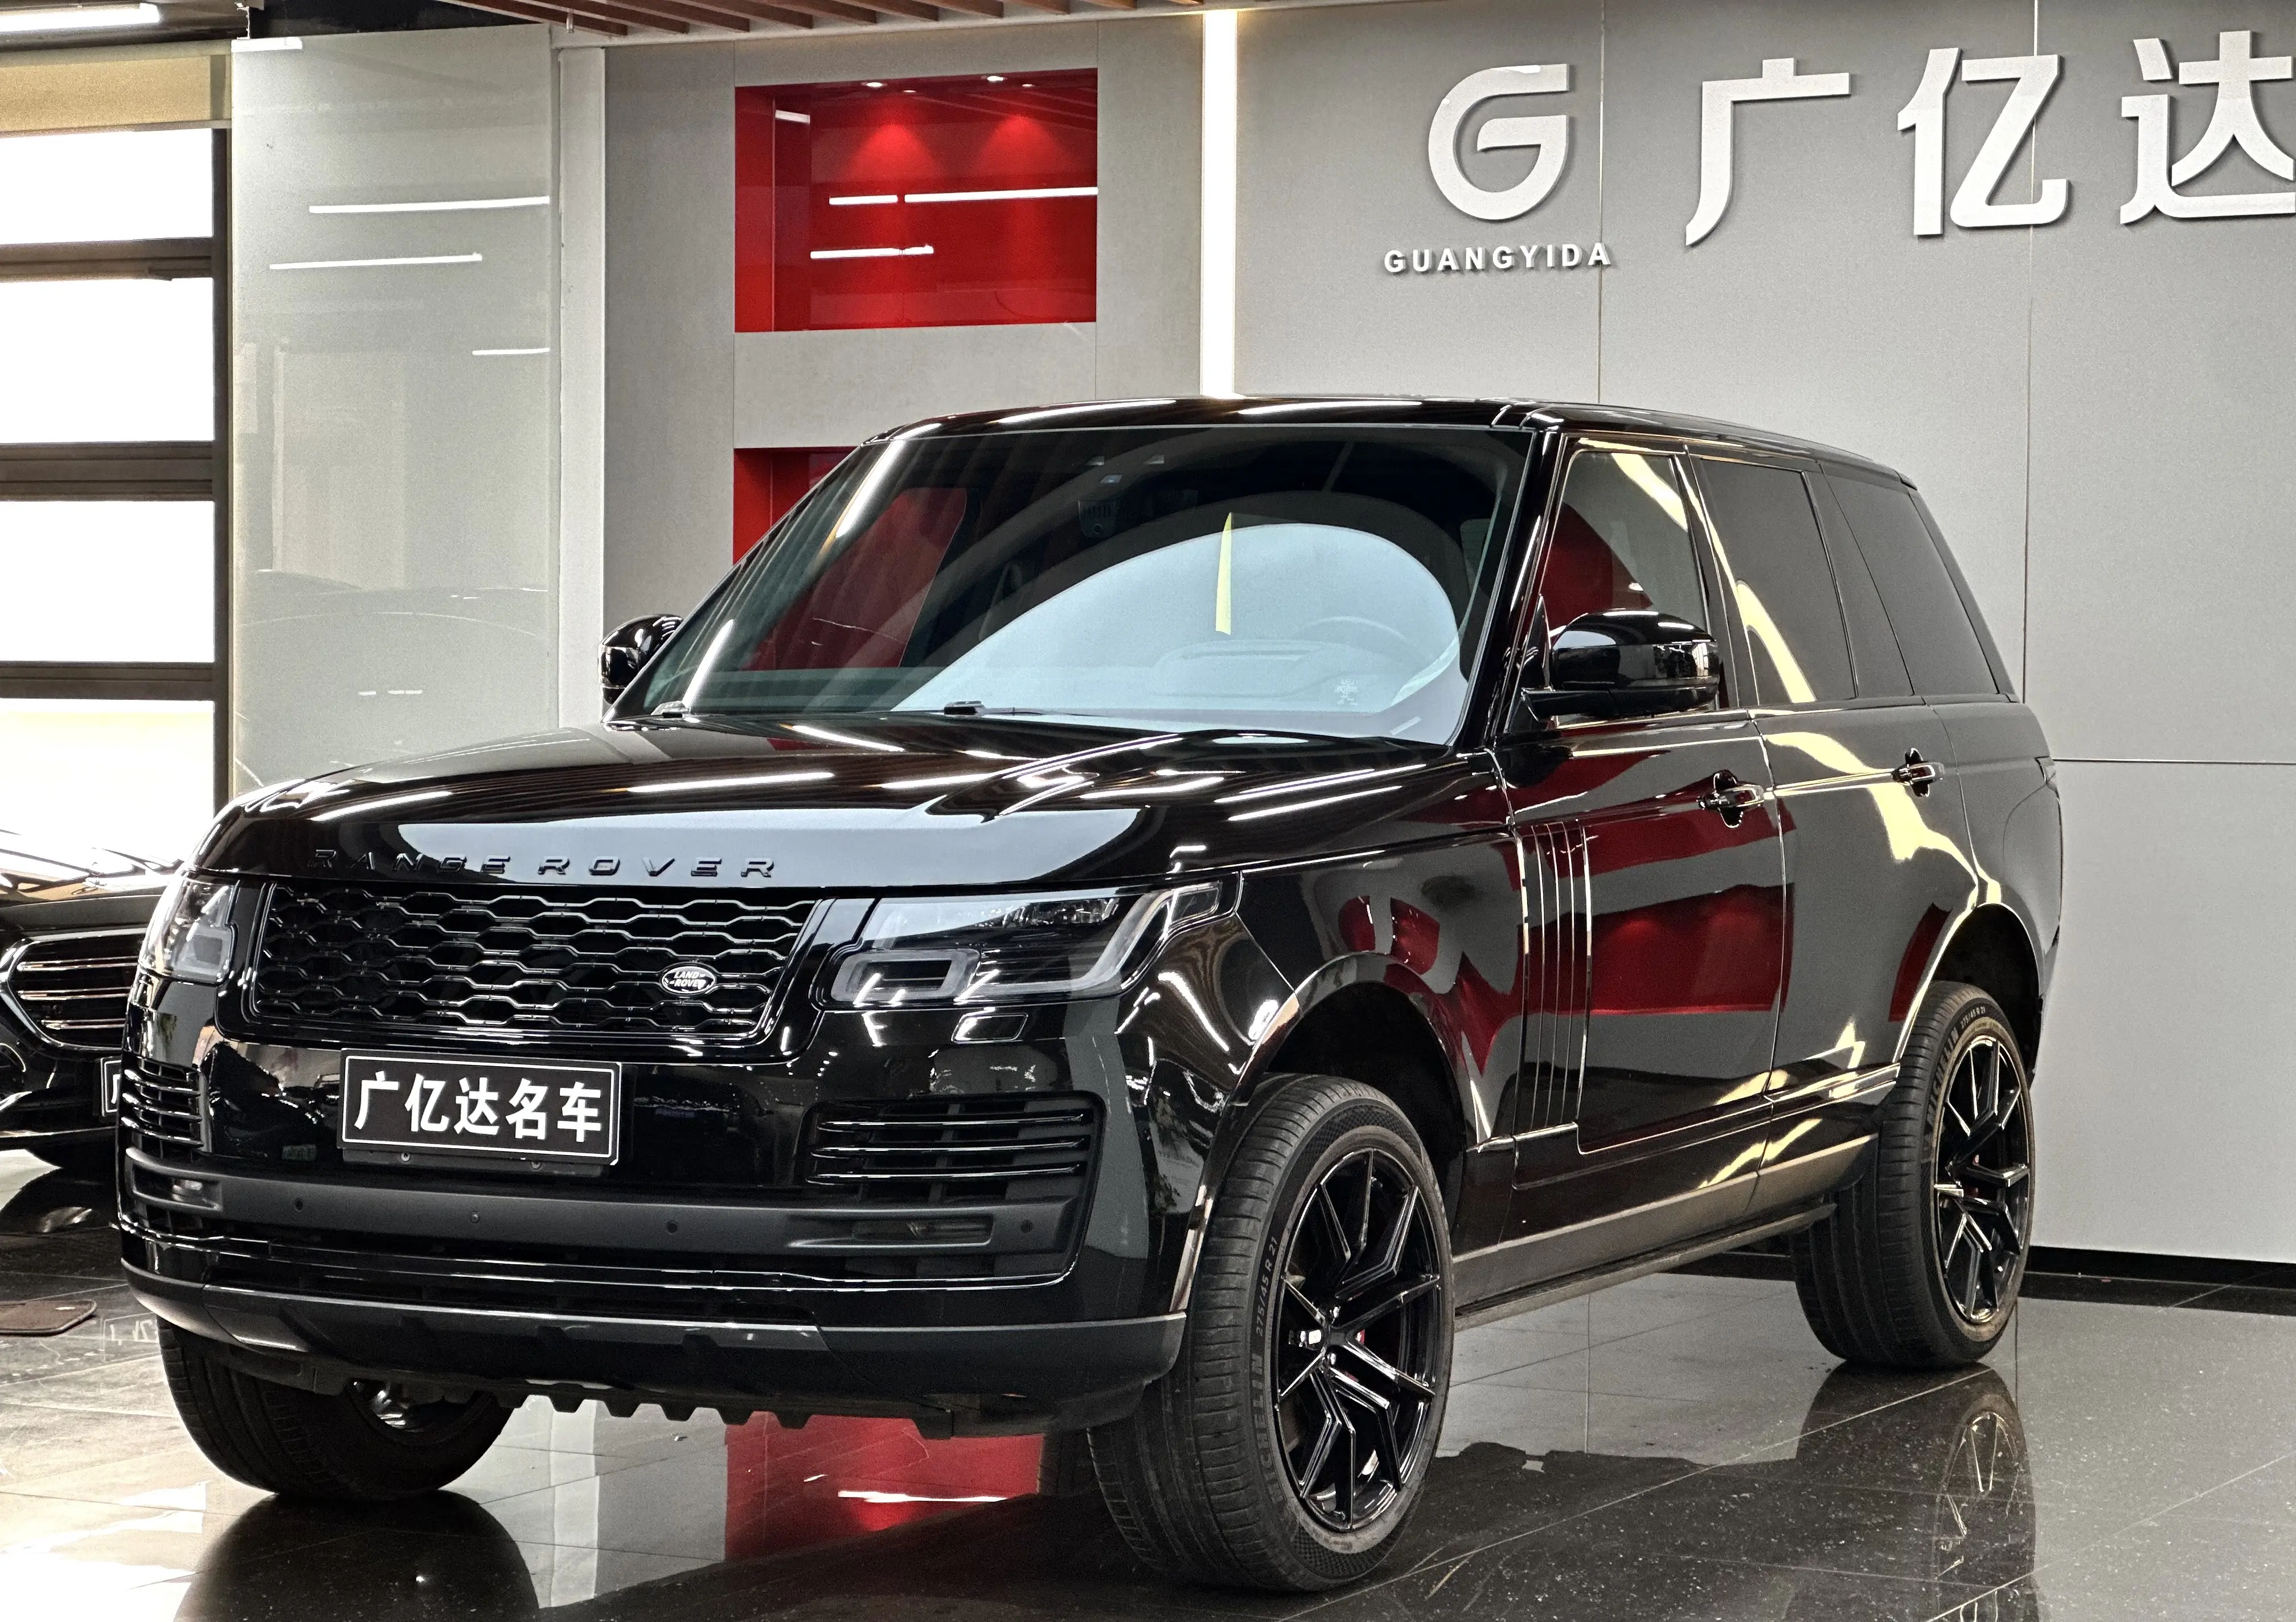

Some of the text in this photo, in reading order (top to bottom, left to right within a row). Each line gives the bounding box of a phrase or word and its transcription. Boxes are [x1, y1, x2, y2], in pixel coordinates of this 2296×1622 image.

[1686, 30, 2296, 246] 广亿达
[1384, 242, 1611, 272] GUANGYIDA
[307, 849, 774, 878] RANGE ROVER
[354, 1070, 601, 1142] 广亿达名车
[1256, 1275, 1269, 1337] 275/45
[1269, 1236, 1278, 1256] 21
